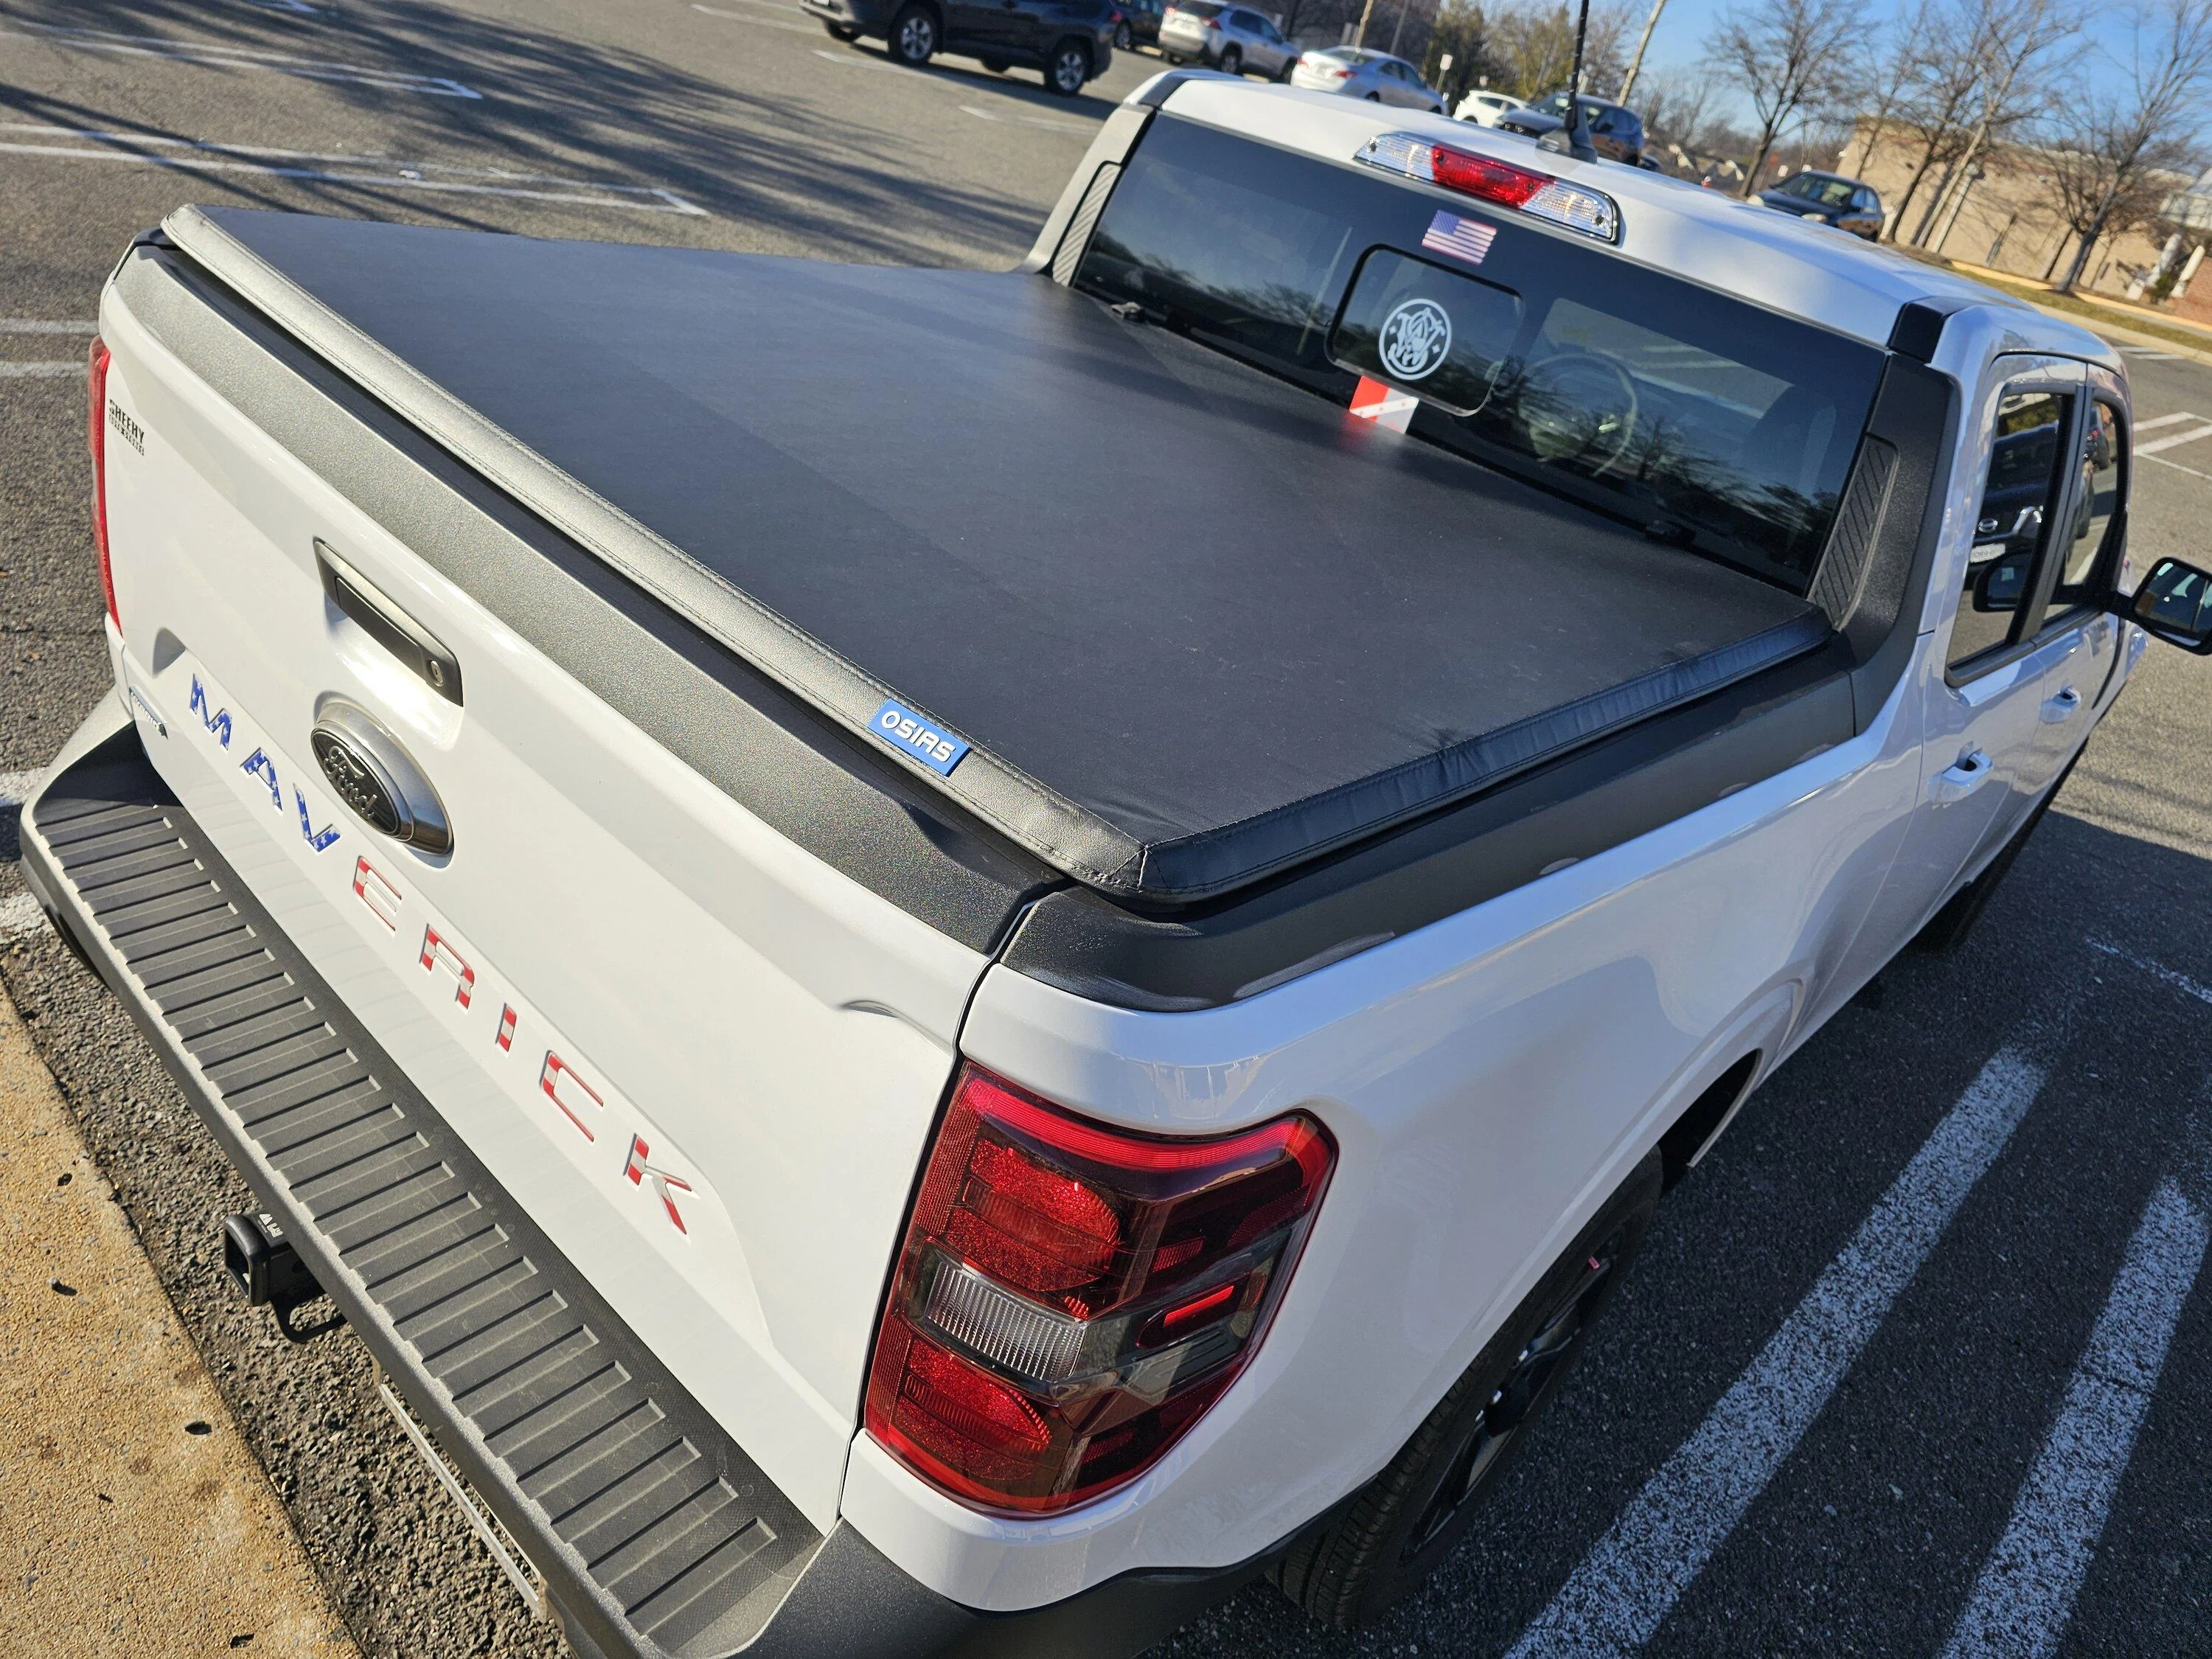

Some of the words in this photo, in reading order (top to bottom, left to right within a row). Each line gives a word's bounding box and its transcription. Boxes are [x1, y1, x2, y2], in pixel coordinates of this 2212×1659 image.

[109, 399, 145, 444] SHEEHY
[881, 710, 957, 762] OSIAS
[323, 745, 378, 818] Ford
[189, 673, 698, 1237] MAVERICK
